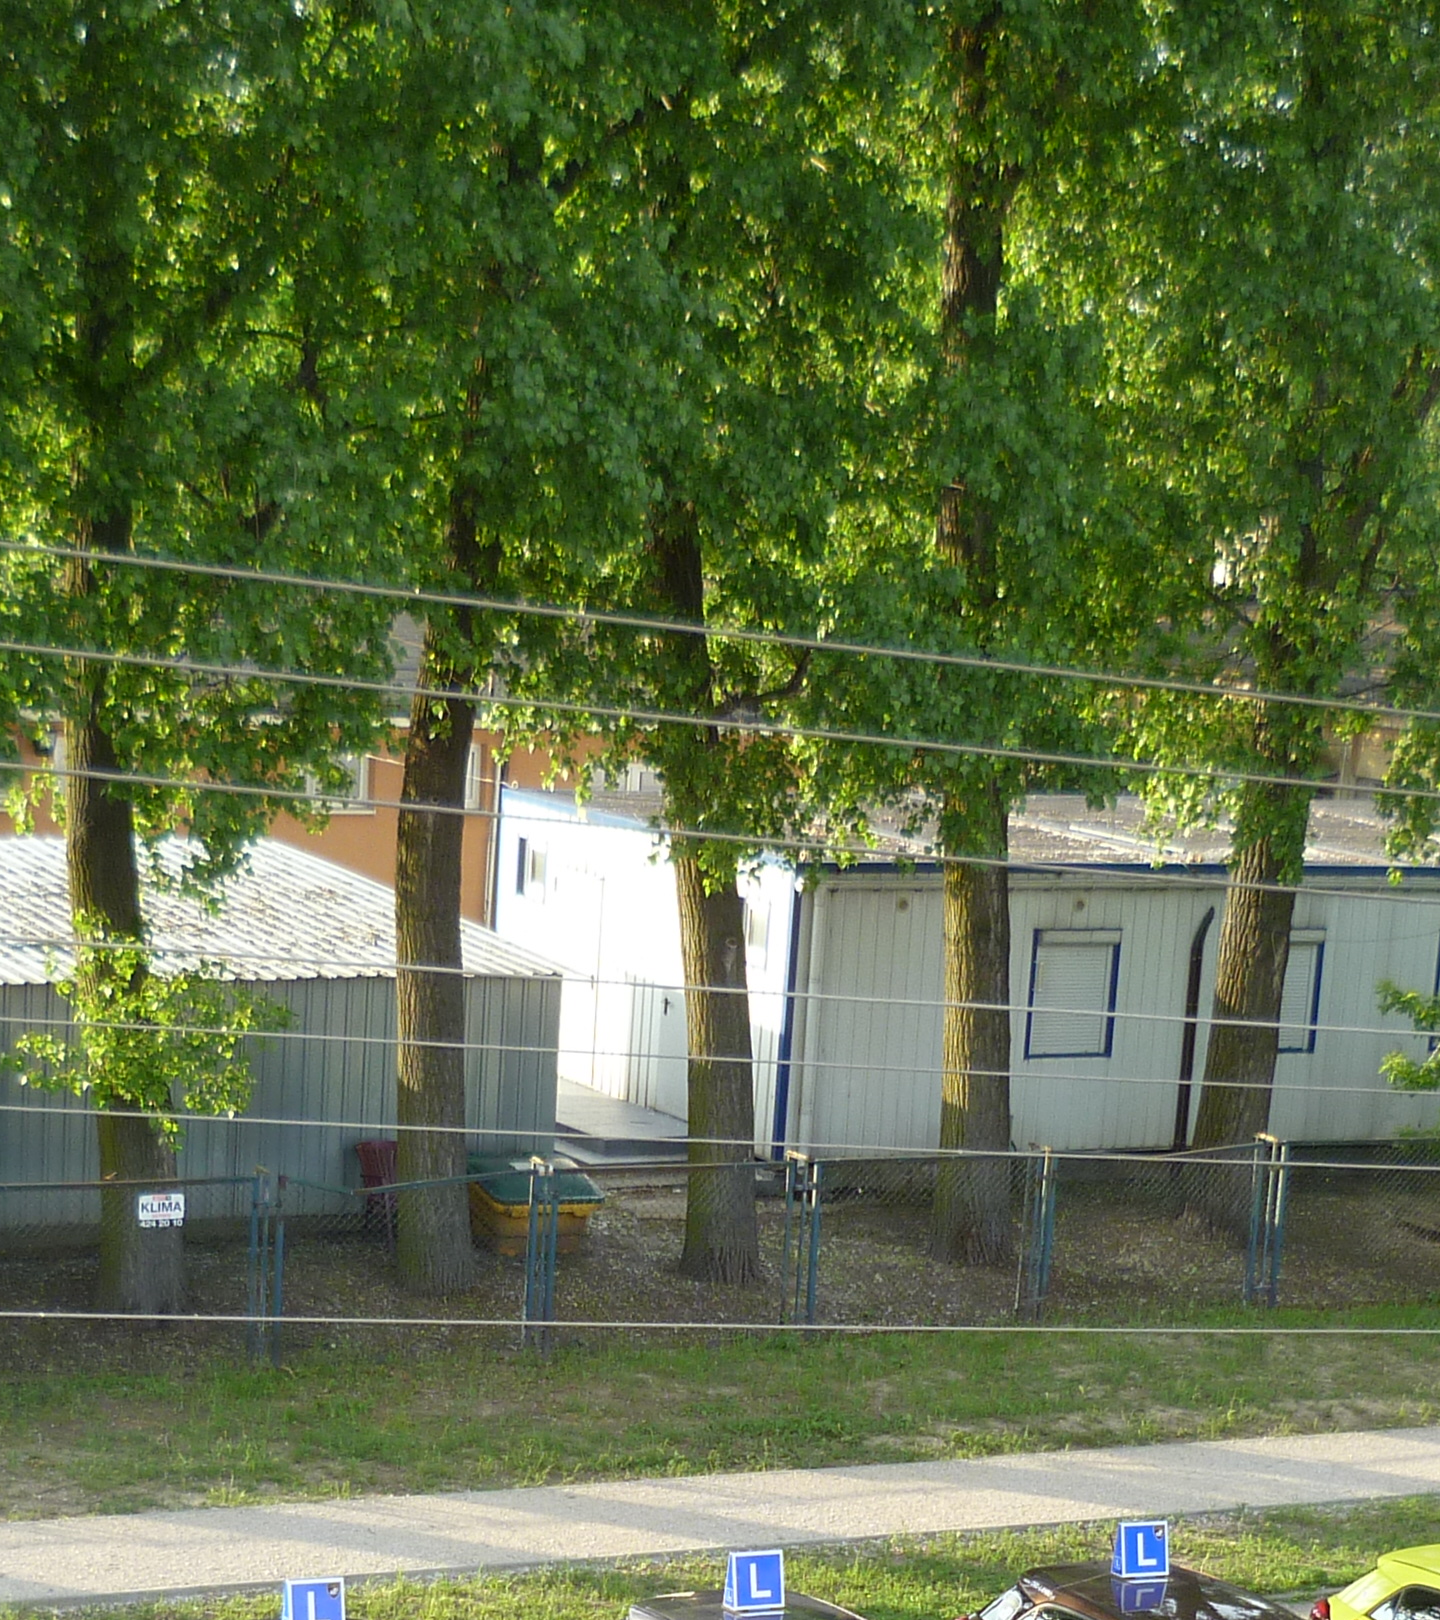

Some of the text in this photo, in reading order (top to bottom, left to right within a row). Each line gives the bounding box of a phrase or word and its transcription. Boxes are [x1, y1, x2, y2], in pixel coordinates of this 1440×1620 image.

[141, 1201, 182, 1213] KLIMA
[173, 1219, 183, 1227] 10
[1136, 1532, 1158, 1567] L
[748, 1562, 773, 1598] L
